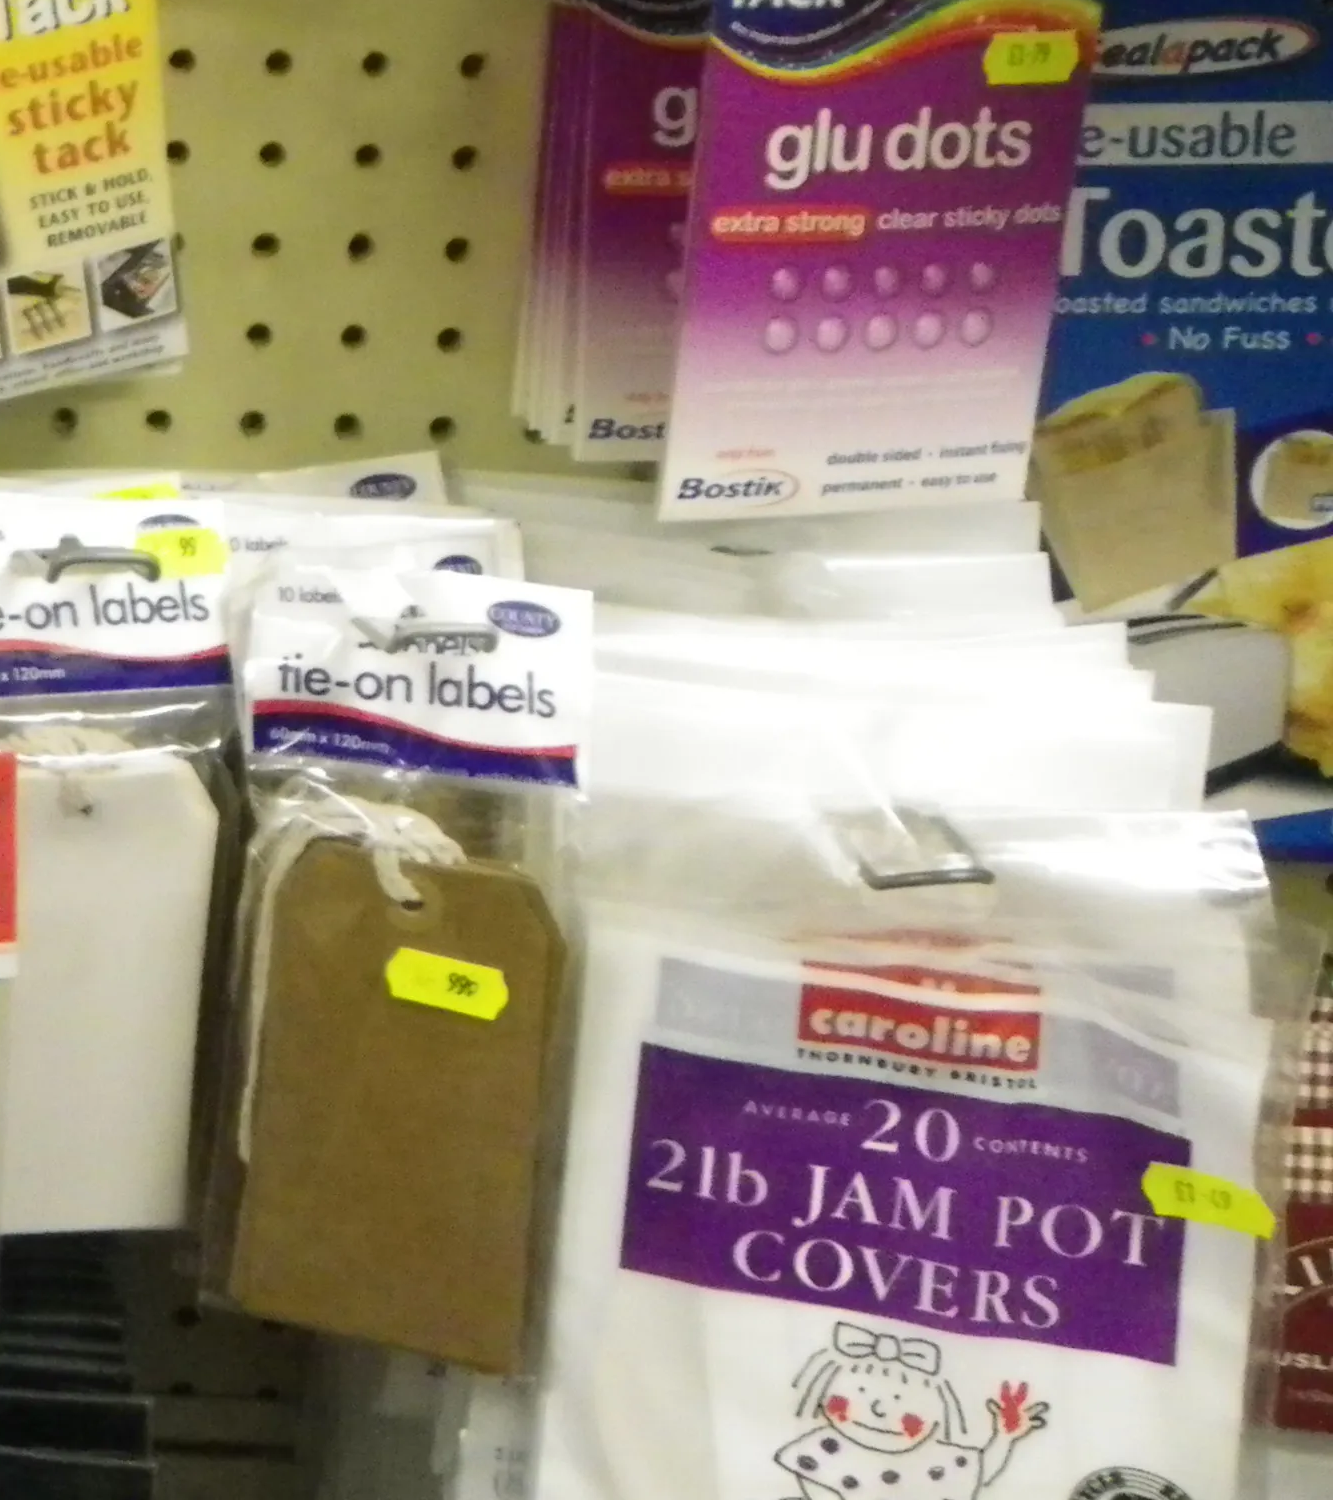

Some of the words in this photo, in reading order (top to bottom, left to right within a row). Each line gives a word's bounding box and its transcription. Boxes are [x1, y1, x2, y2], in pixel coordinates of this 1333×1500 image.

[8, 79, 139, 137] sticky
[32, 121, 131, 175] tack
[765, 107, 871, 191] glu
[885, 106, 1032, 171] dots
[1080, 109, 1298, 159] e-usable
[30, 187, 77, 210] STICK
[37, 210, 82, 230] EASY
[86, 198, 109, 217] TO
[713, 214, 779, 235] extra
[784, 210, 866, 236] strong
[877, 206, 938, 230] clear
[944, 204, 1009, 229] sticky
[1014, 202, 1062, 224] dots
[46, 210, 148, 249] REMOVABLE
[1057, 292, 1147, 314] oasted
[1159, 290, 1318, 314] sandwiches
[1168, 326, 1209, 350] No
[1222, 327, 1291, 349] Fuss
[587, 418, 666, 443] Bost
[678, 475, 785, 502] Bostik
[822, 477, 903, 497] permanent
[921, 475, 952, 488] easy
[90, 580, 209, 626] labels
[278, 653, 414, 704] tie-on
[428, 661, 557, 718] labels
[809, 1000, 1032, 1063] caroline
[797, 1047, 935, 1080] THORNBURY
[950, 1069, 1038, 1092] BRISTOL
[742, 1099, 853, 1128] AVERAGE
[860, 1099, 961, 1163] 20
[974, 1134, 1089, 1165] CONTENTS
[792, 1163, 954, 1242] JAM
[995, 1196, 1166, 1268] POT
[732, 1230, 1062, 1331] COVERS
